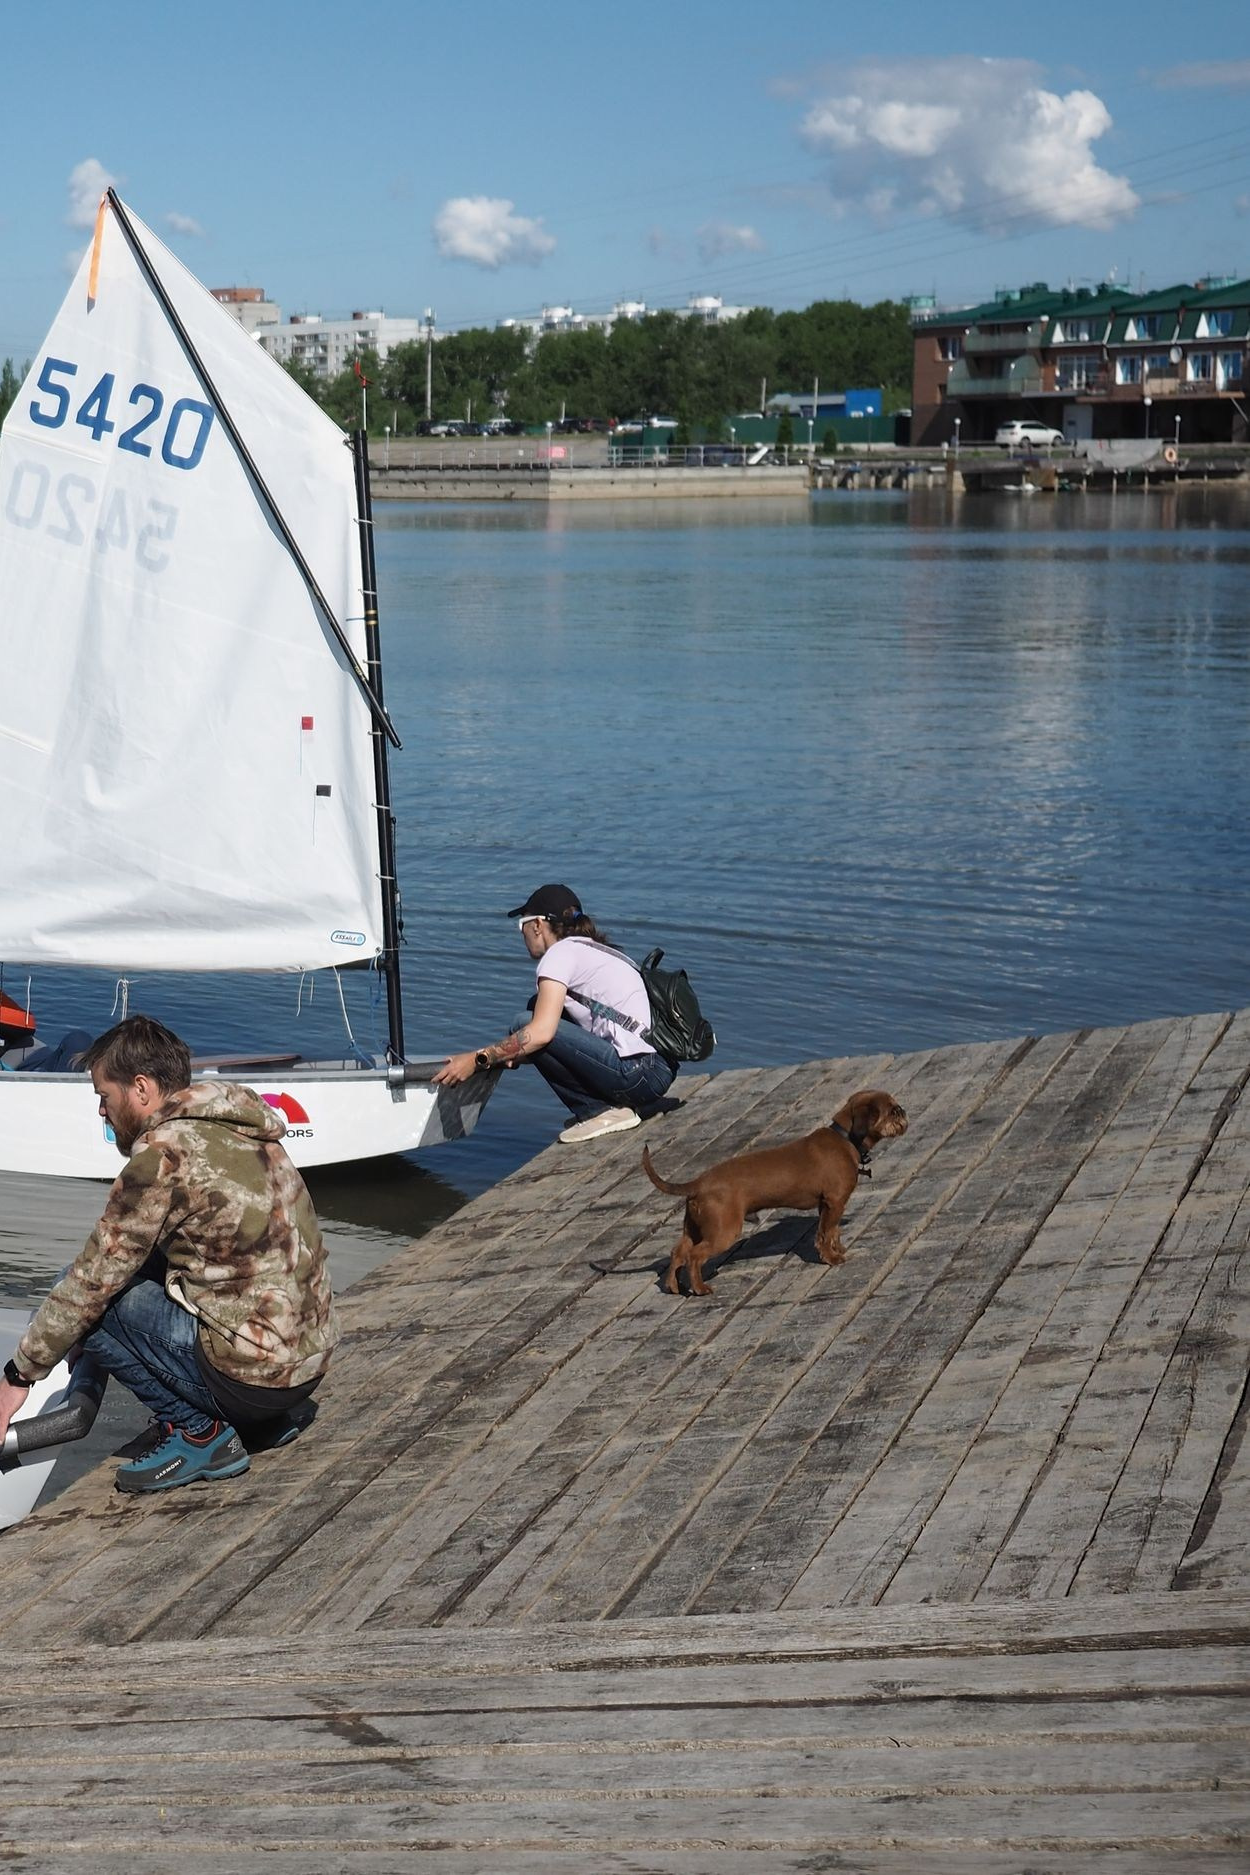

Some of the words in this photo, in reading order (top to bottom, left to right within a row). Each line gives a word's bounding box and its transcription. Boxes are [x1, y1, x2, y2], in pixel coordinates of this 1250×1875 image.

[29, 356, 215, 471] 5420
[286, 1129, 314, 1138] ORS
[155, 1459, 182, 1480] GARMONT
